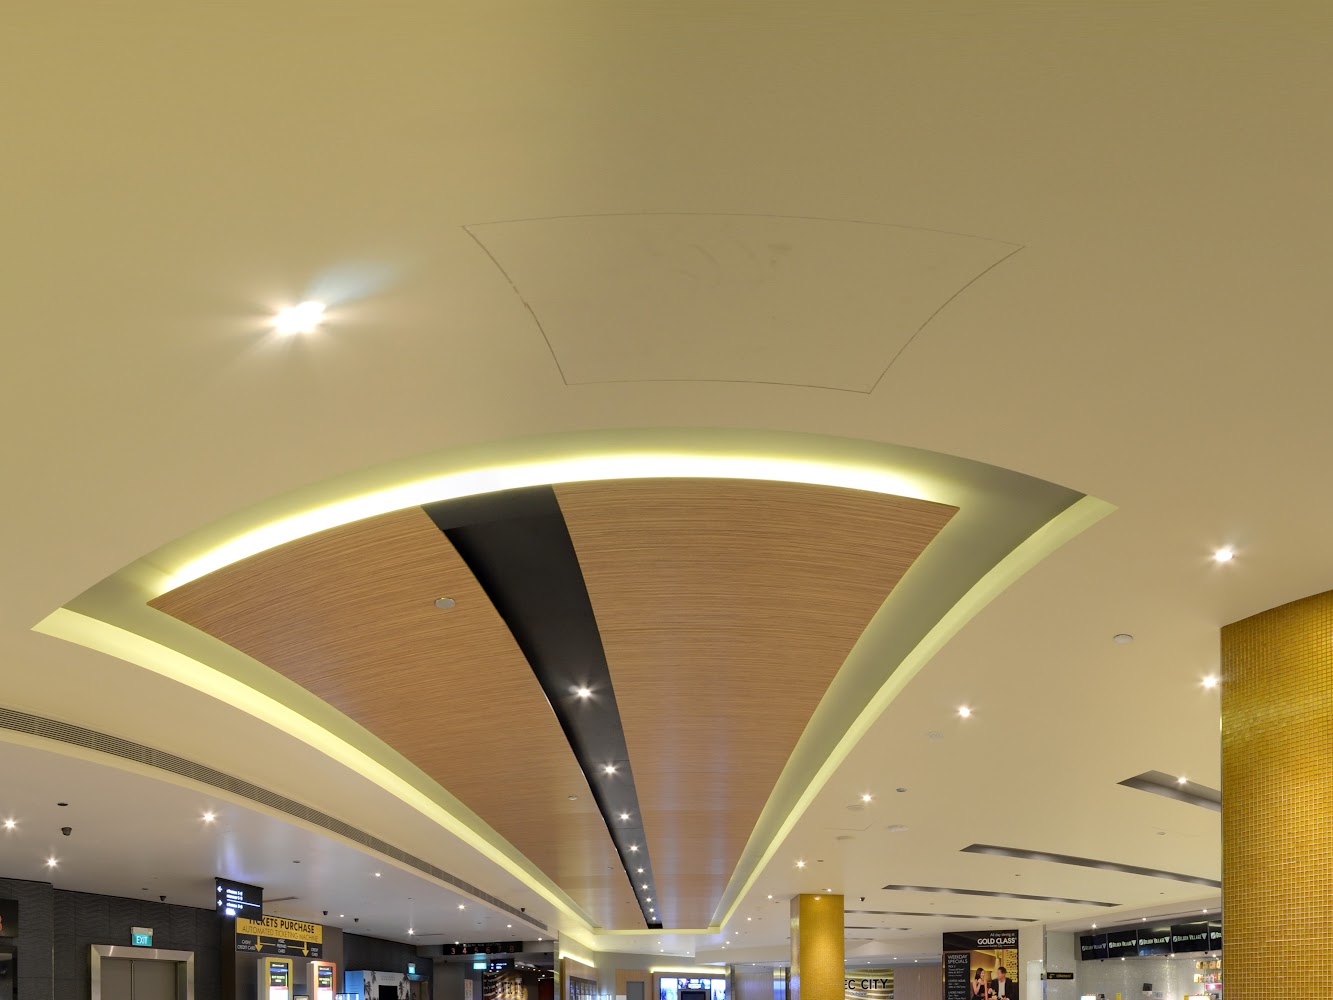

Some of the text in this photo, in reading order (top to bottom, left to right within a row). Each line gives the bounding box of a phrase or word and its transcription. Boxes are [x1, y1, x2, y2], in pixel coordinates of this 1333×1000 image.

[249, 917, 315, 933] TICKETS PURCHASE
[243, 926, 273, 935] AUTOMATED
[275, 930, 298, 939] TICKETING
[136, 936, 148, 944] EXIT
[861, 979, 888, 990] CITY
